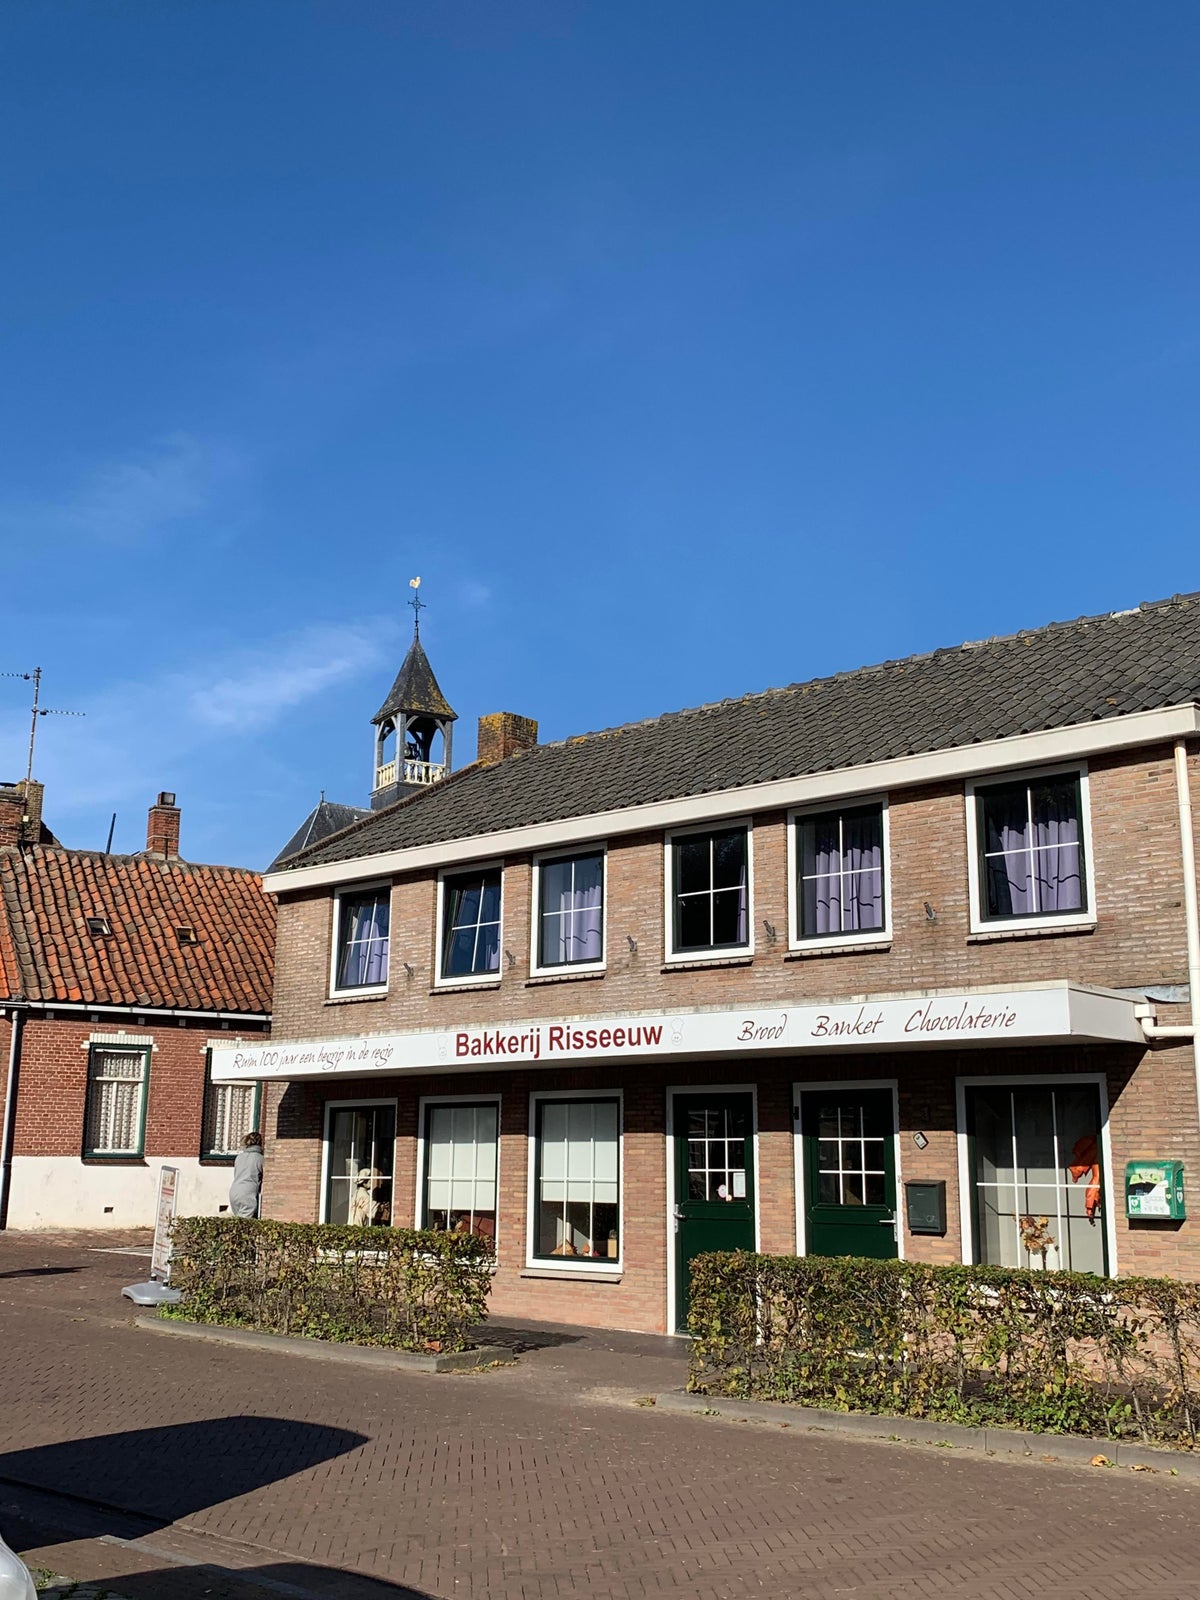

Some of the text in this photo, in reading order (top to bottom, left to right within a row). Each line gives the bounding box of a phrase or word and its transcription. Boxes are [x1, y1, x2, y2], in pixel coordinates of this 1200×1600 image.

[736, 1001, 1017, 1041] Brood Banket Chocolaterie
[232, 1040, 394, 1072] Ruim 100 jaar een begrip in de regio
[455, 1025, 663, 1059] Bakkerij Risseeuw
